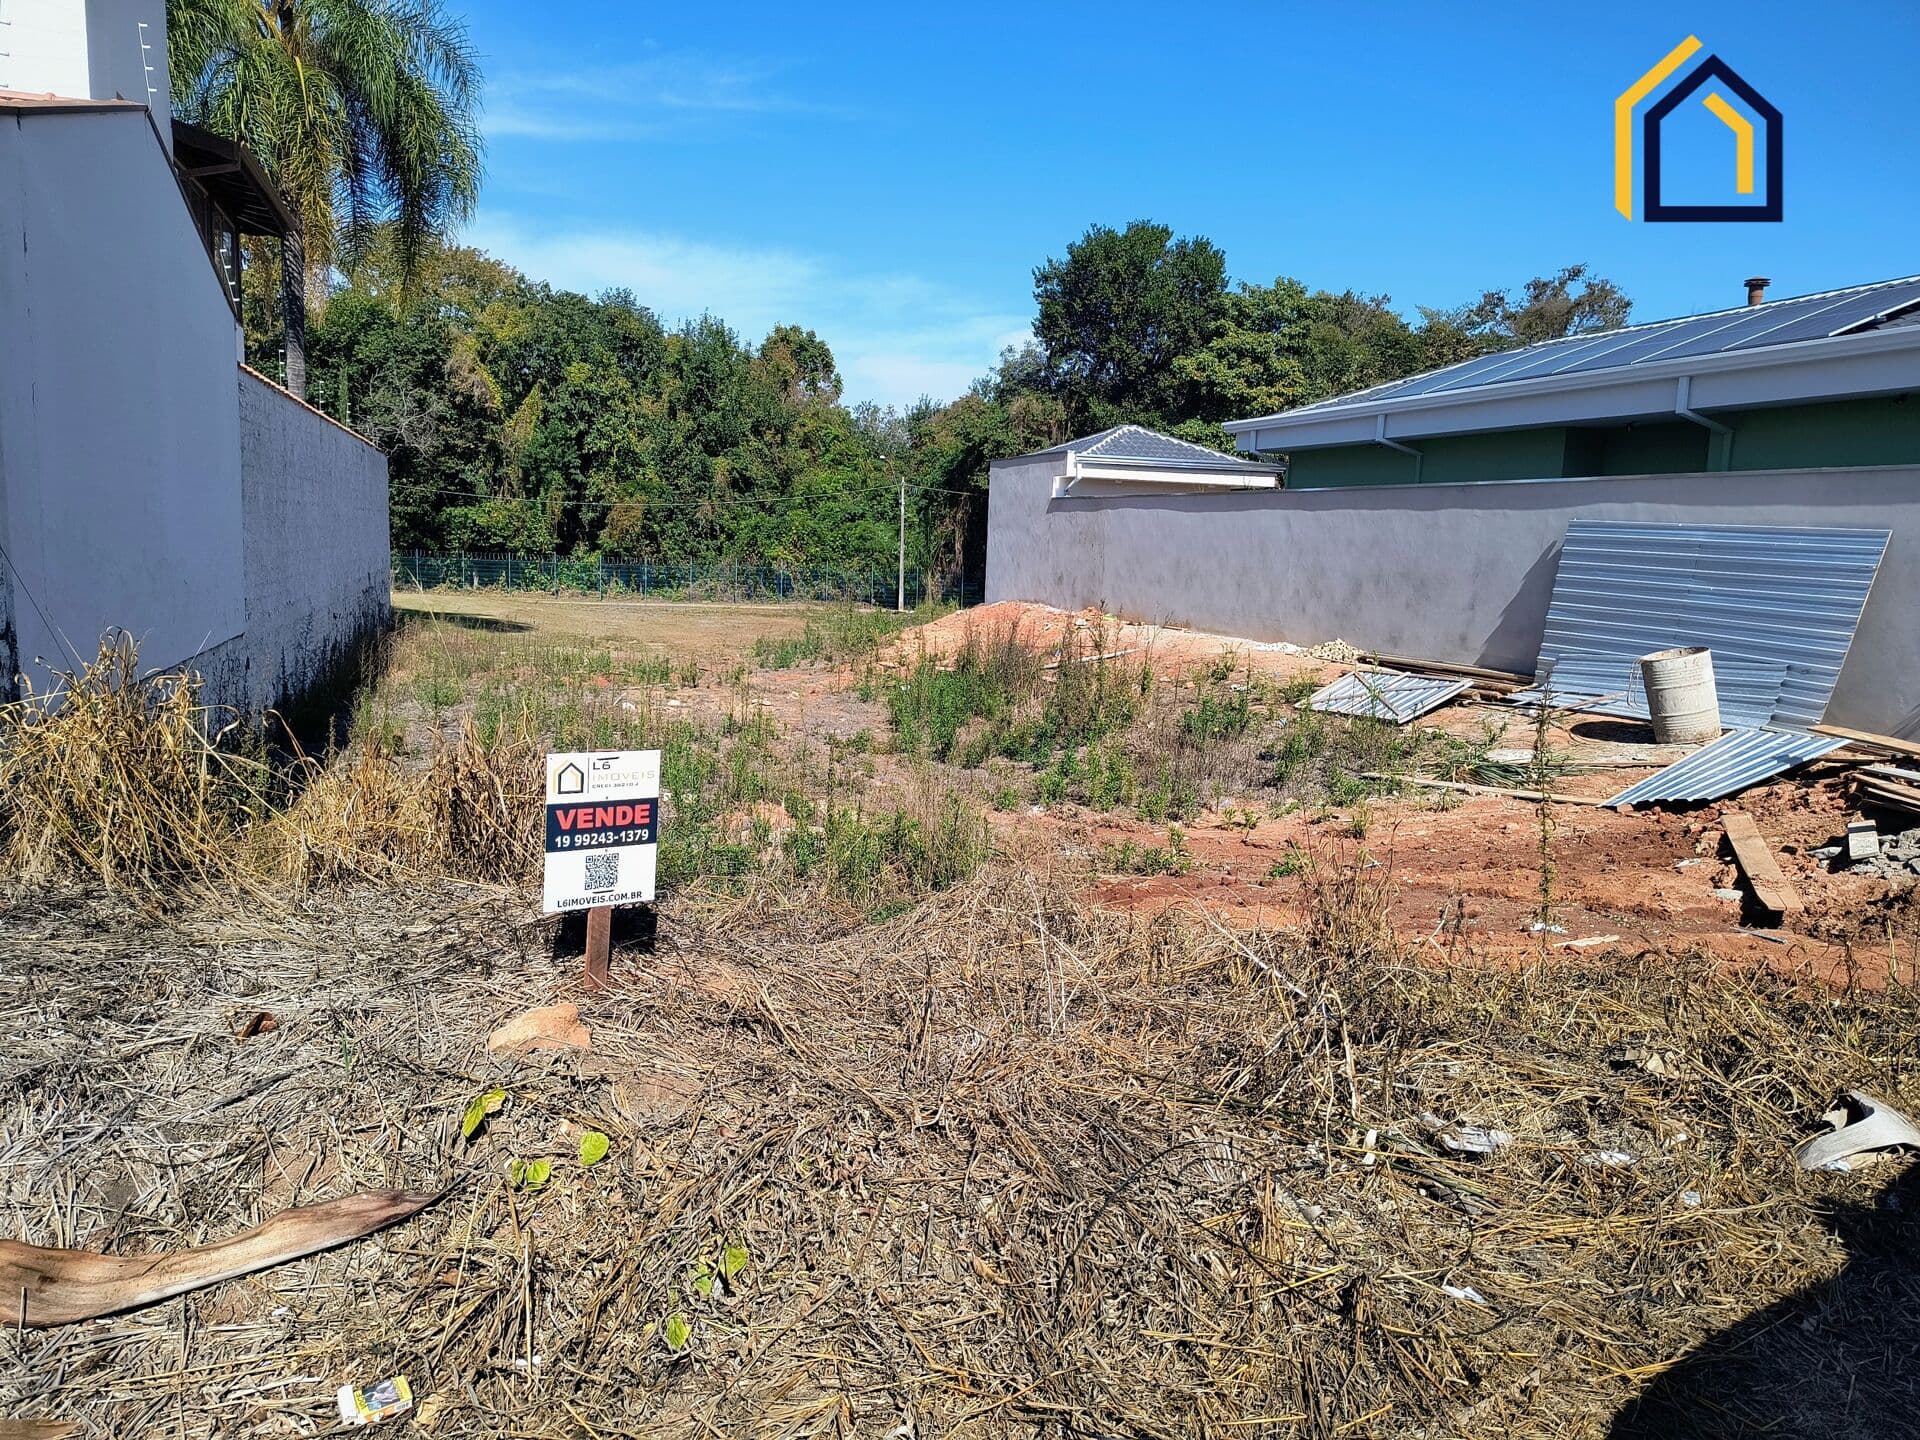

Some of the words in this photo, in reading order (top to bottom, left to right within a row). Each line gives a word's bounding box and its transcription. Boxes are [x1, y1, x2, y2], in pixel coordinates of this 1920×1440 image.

[592, 761, 611, 770] L6
[556, 804, 650, 830] VENDE
[555, 835, 570, 848] 19
[574, 829, 649, 847] 99243-1379
[557, 891, 642, 908] L6IMOVEIS.COM.BR
